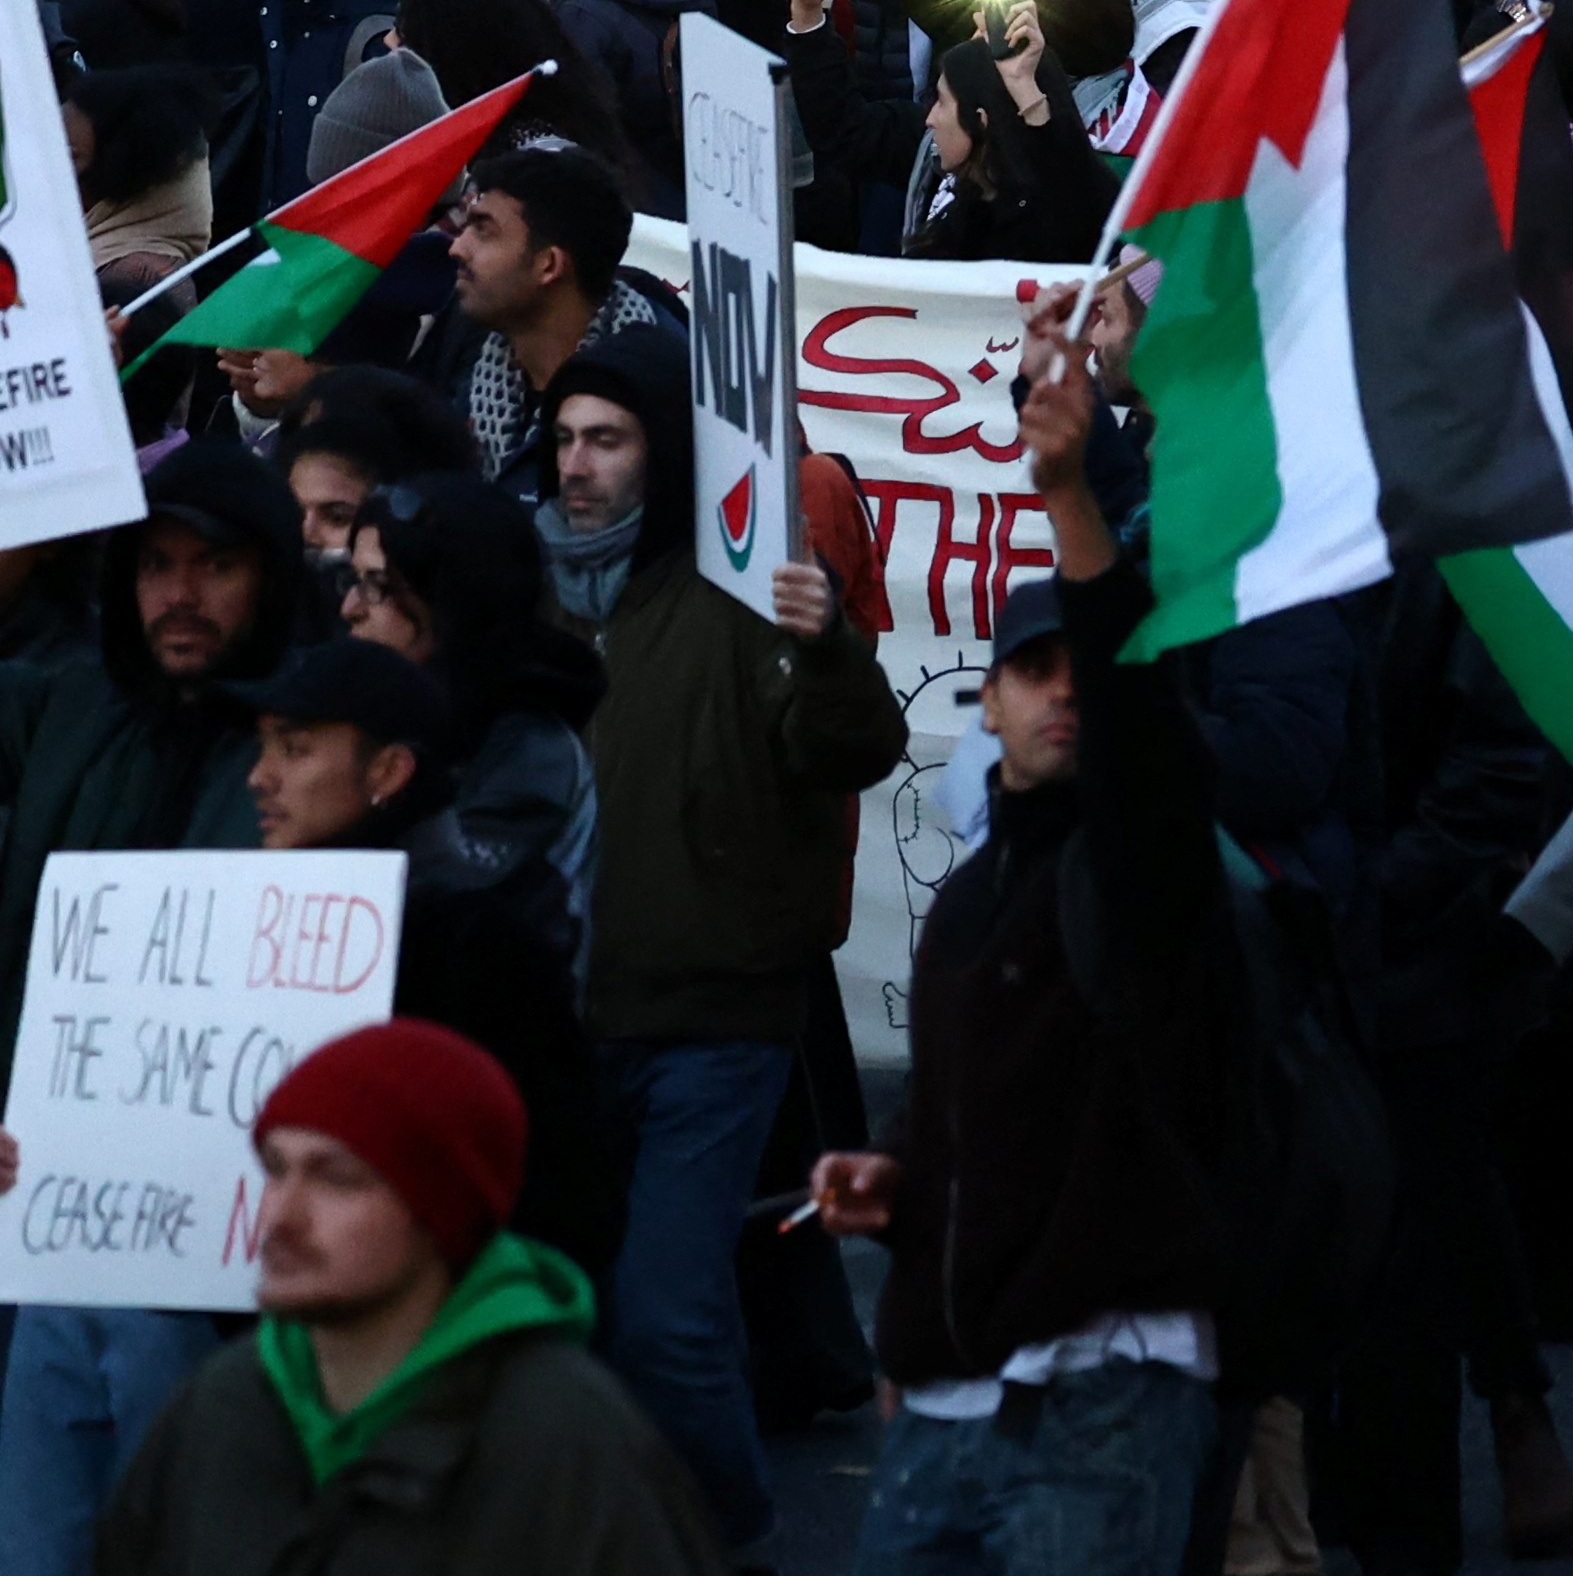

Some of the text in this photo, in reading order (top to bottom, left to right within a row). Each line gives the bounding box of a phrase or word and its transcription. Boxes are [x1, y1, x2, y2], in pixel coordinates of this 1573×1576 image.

[691, 237, 778, 461] NOW
[52, 883, 385, 995] WE ALL BLEED
[48, 1014, 111, 1101] THE
[118, 1016, 224, 1117] SAME
